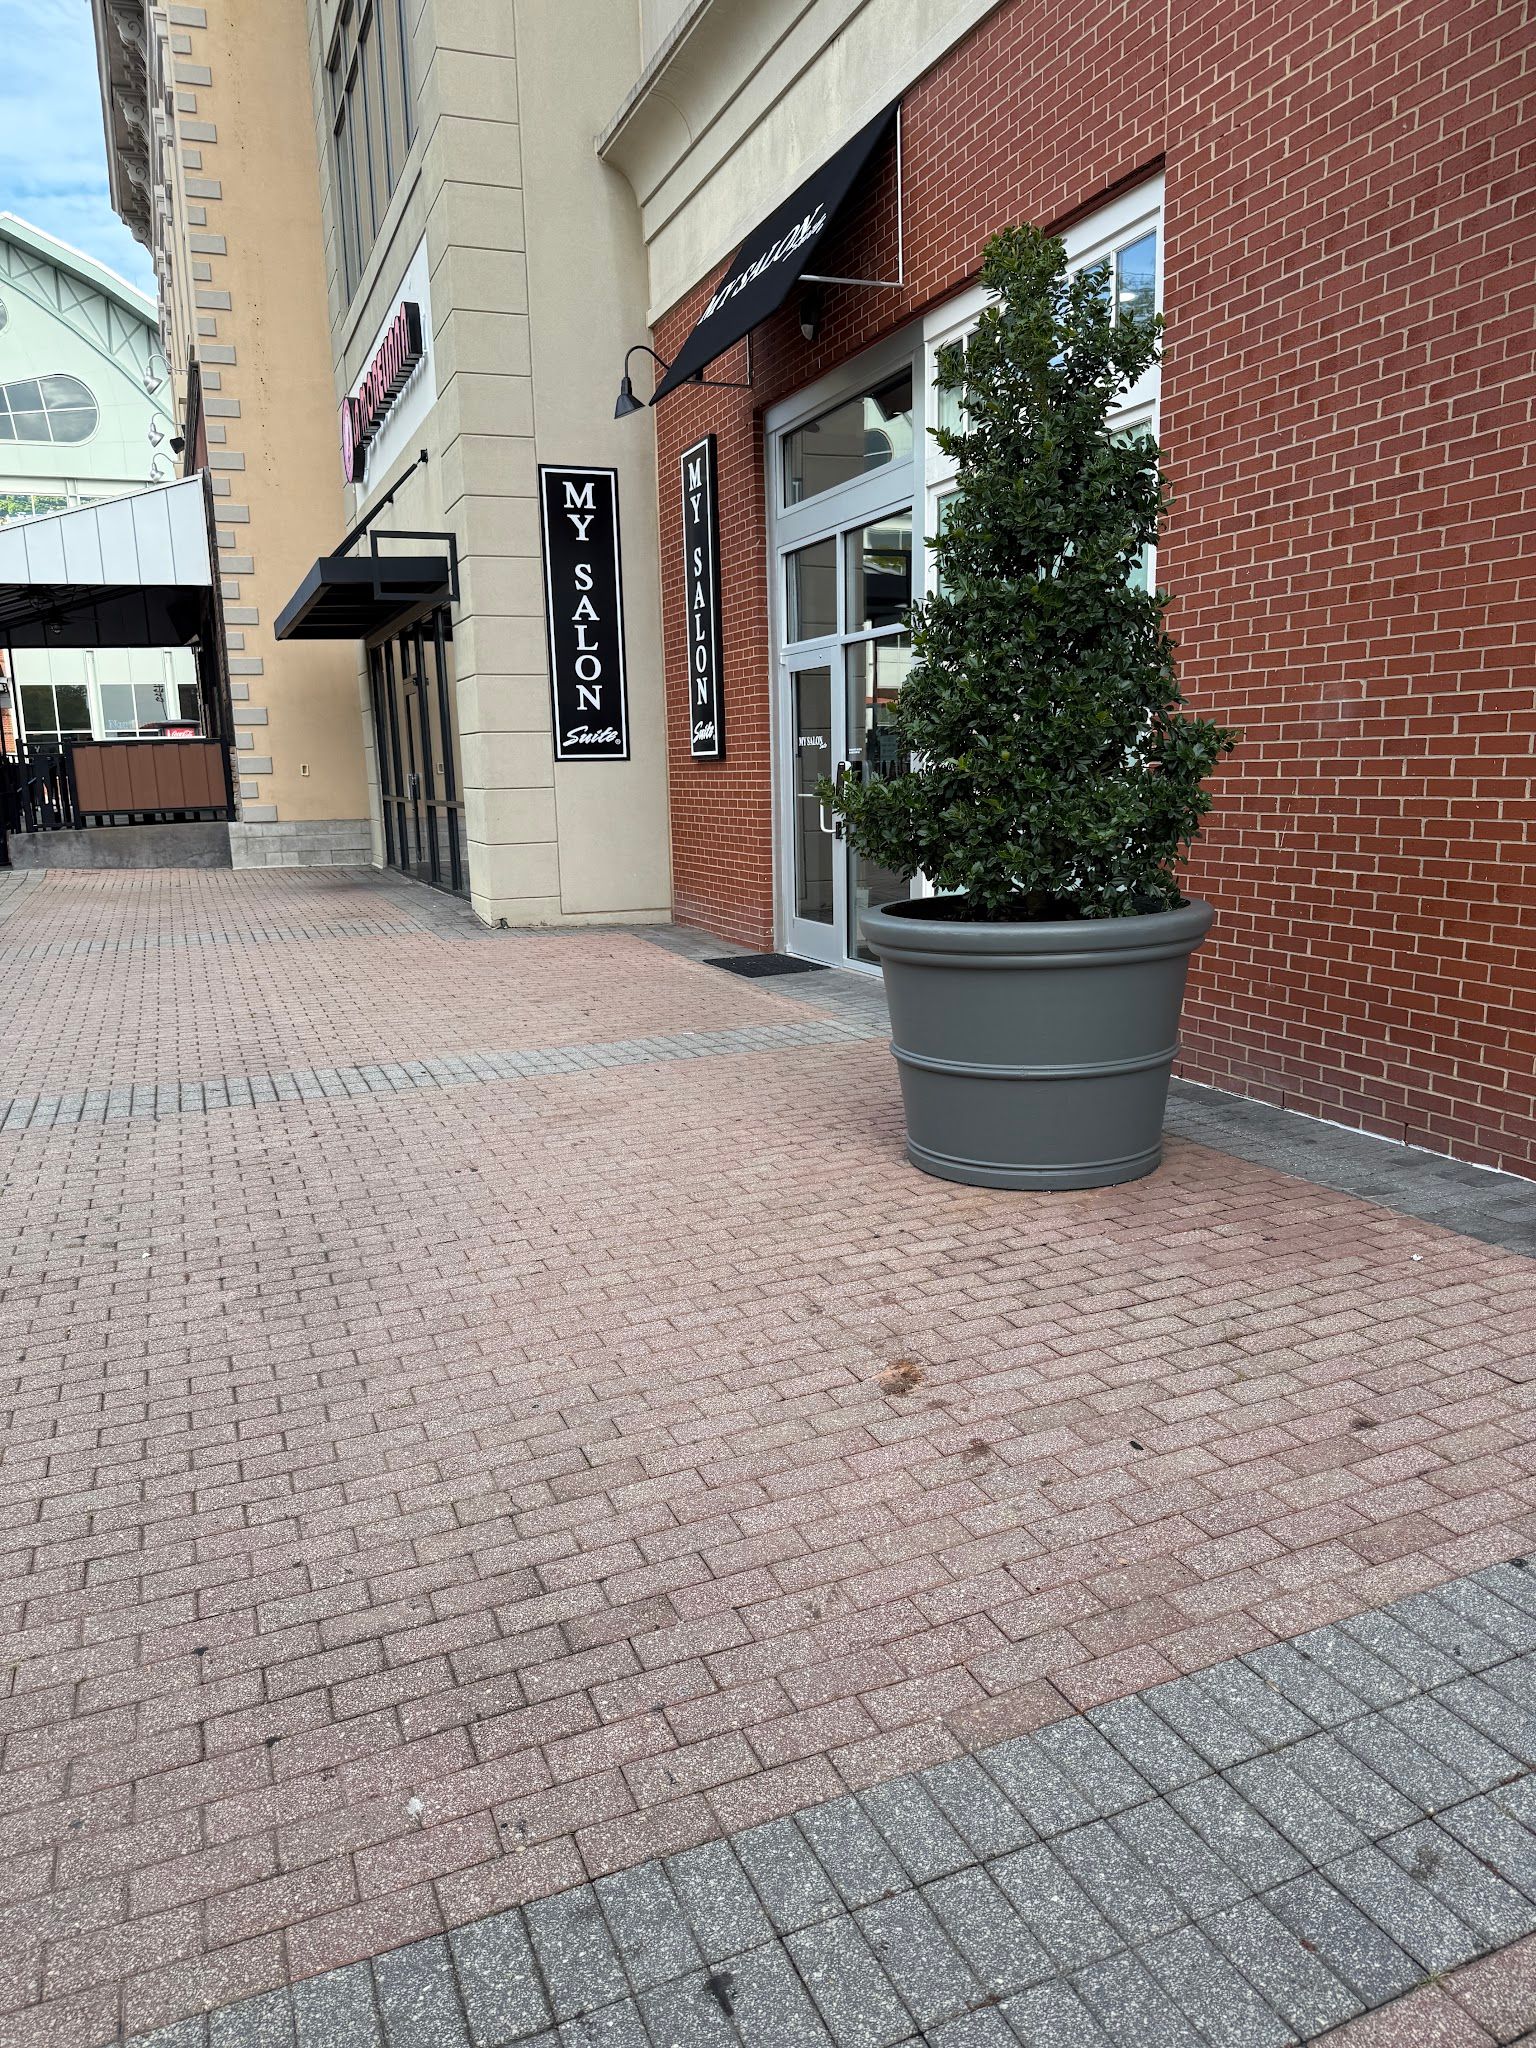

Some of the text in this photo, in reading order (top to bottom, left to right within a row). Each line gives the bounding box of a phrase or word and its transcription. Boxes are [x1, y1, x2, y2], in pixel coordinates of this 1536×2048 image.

[696, 203, 825, 326] MY SALON
[562, 481, 603, 711] MY SALON
[688, 457, 708, 706] MY SALON
[562, 725, 617, 747] Suite
[693, 720, 714, 744] Suite
